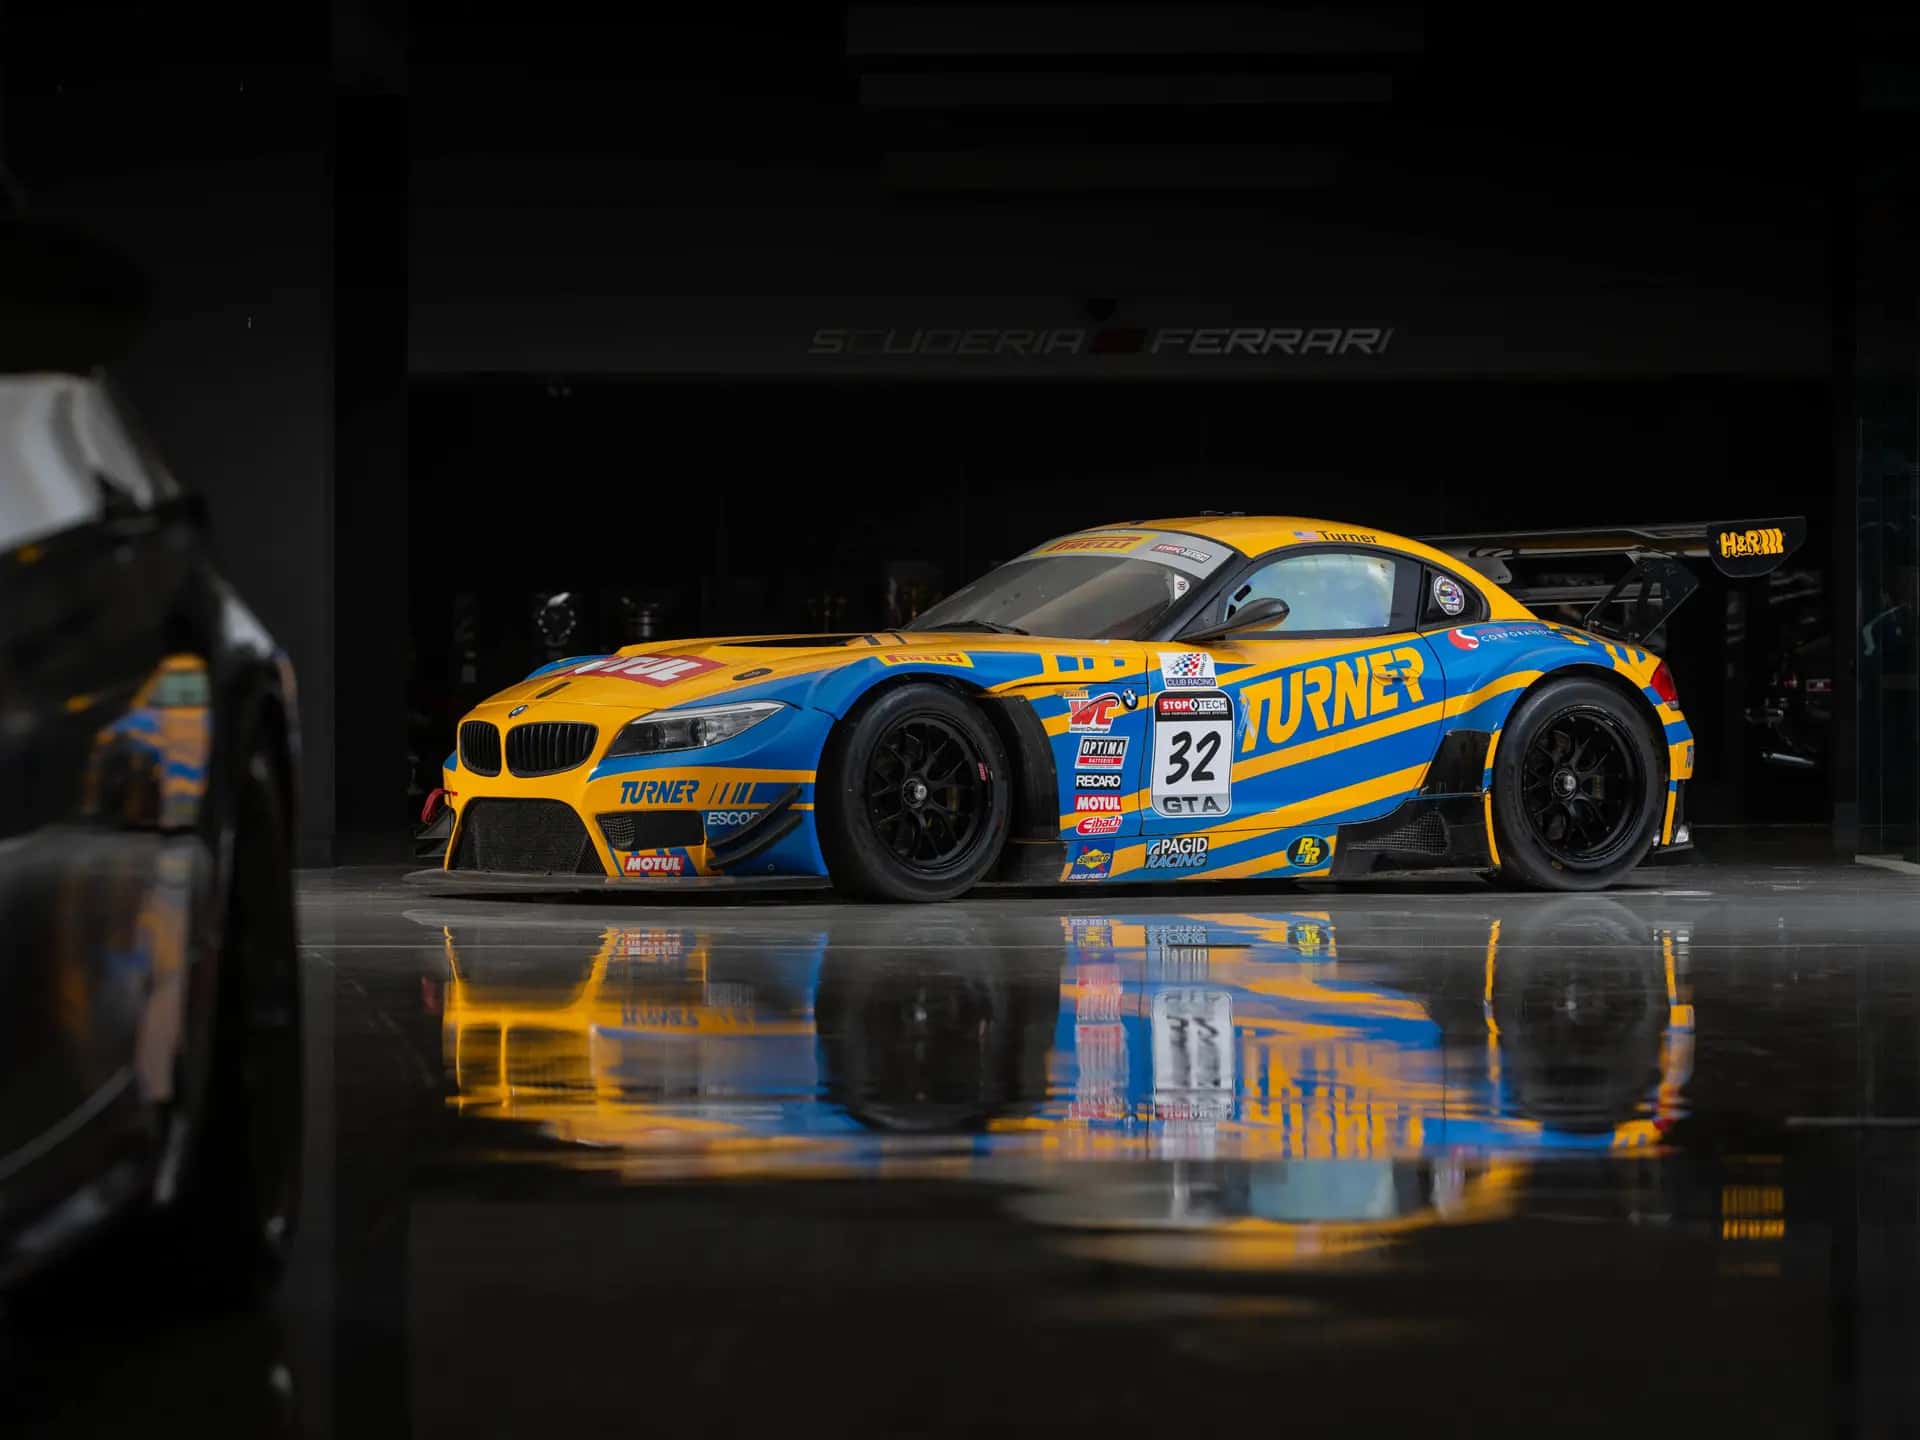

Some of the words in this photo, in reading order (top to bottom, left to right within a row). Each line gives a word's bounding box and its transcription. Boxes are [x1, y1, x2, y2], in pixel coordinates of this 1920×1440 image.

[808, 328, 1087, 355] SCUDERIA
[1152, 328, 1395, 355] FERRARI
[1315, 530, 1377, 543] Turner
[1239, 647, 1425, 753] TURNER
[1082, 741, 1124, 755] OPTIMA
[1165, 731, 1221, 785] 32
[1076, 775, 1121, 787] RECARO
[620, 780, 700, 804] TURNER
[1076, 797, 1121, 810] MOTUL
[1162, 796, 1222, 813] GTA
[1077, 816, 1122, 834] Eibach
[1161, 838, 1207, 854] PAGID
[626, 857, 681, 870] MOTUL
[1146, 853, 1207, 868] RACING
